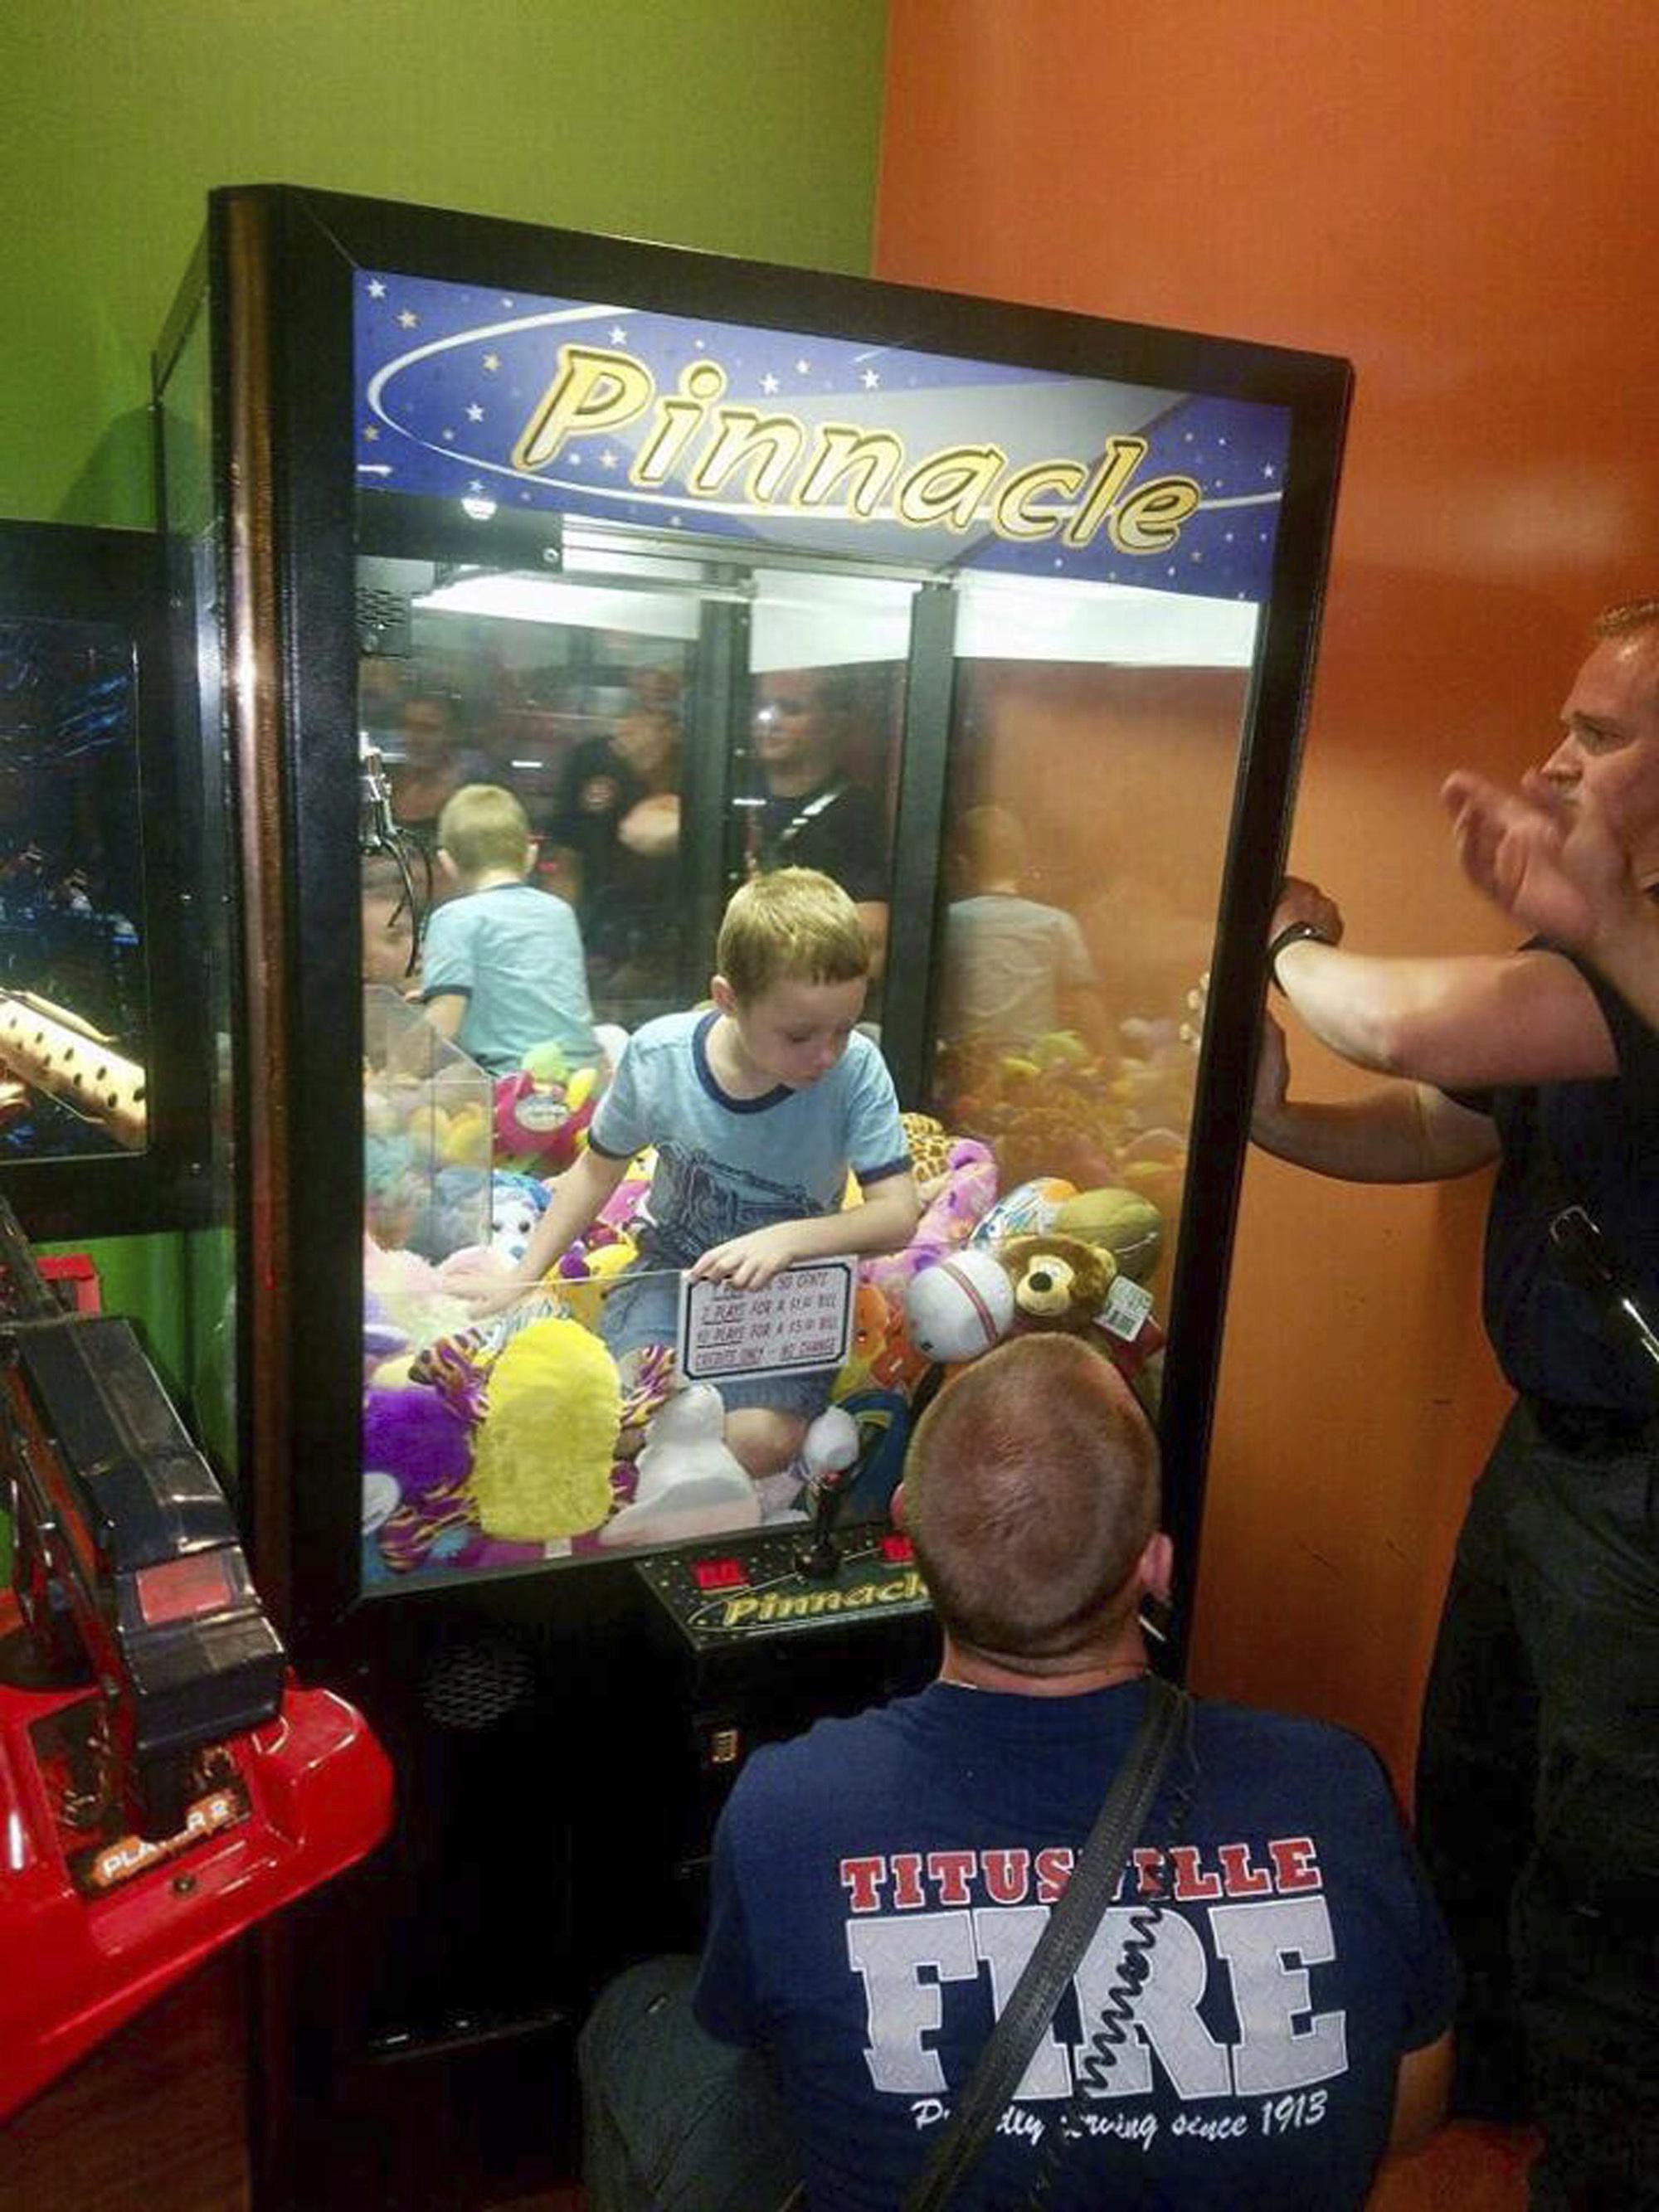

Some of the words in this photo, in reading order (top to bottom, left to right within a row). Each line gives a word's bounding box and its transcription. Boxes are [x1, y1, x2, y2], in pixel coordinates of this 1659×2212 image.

[510, 343, 1202, 556] Pinnacle
[751, 1321, 771, 1340] FOR
[752, 1297, 771, 1315] FOR
[840, 1837, 1323, 1912] TITUSILLE
[1171, 2109, 1247, 2140] since
[1259, 2088, 1327, 2137] 1913
